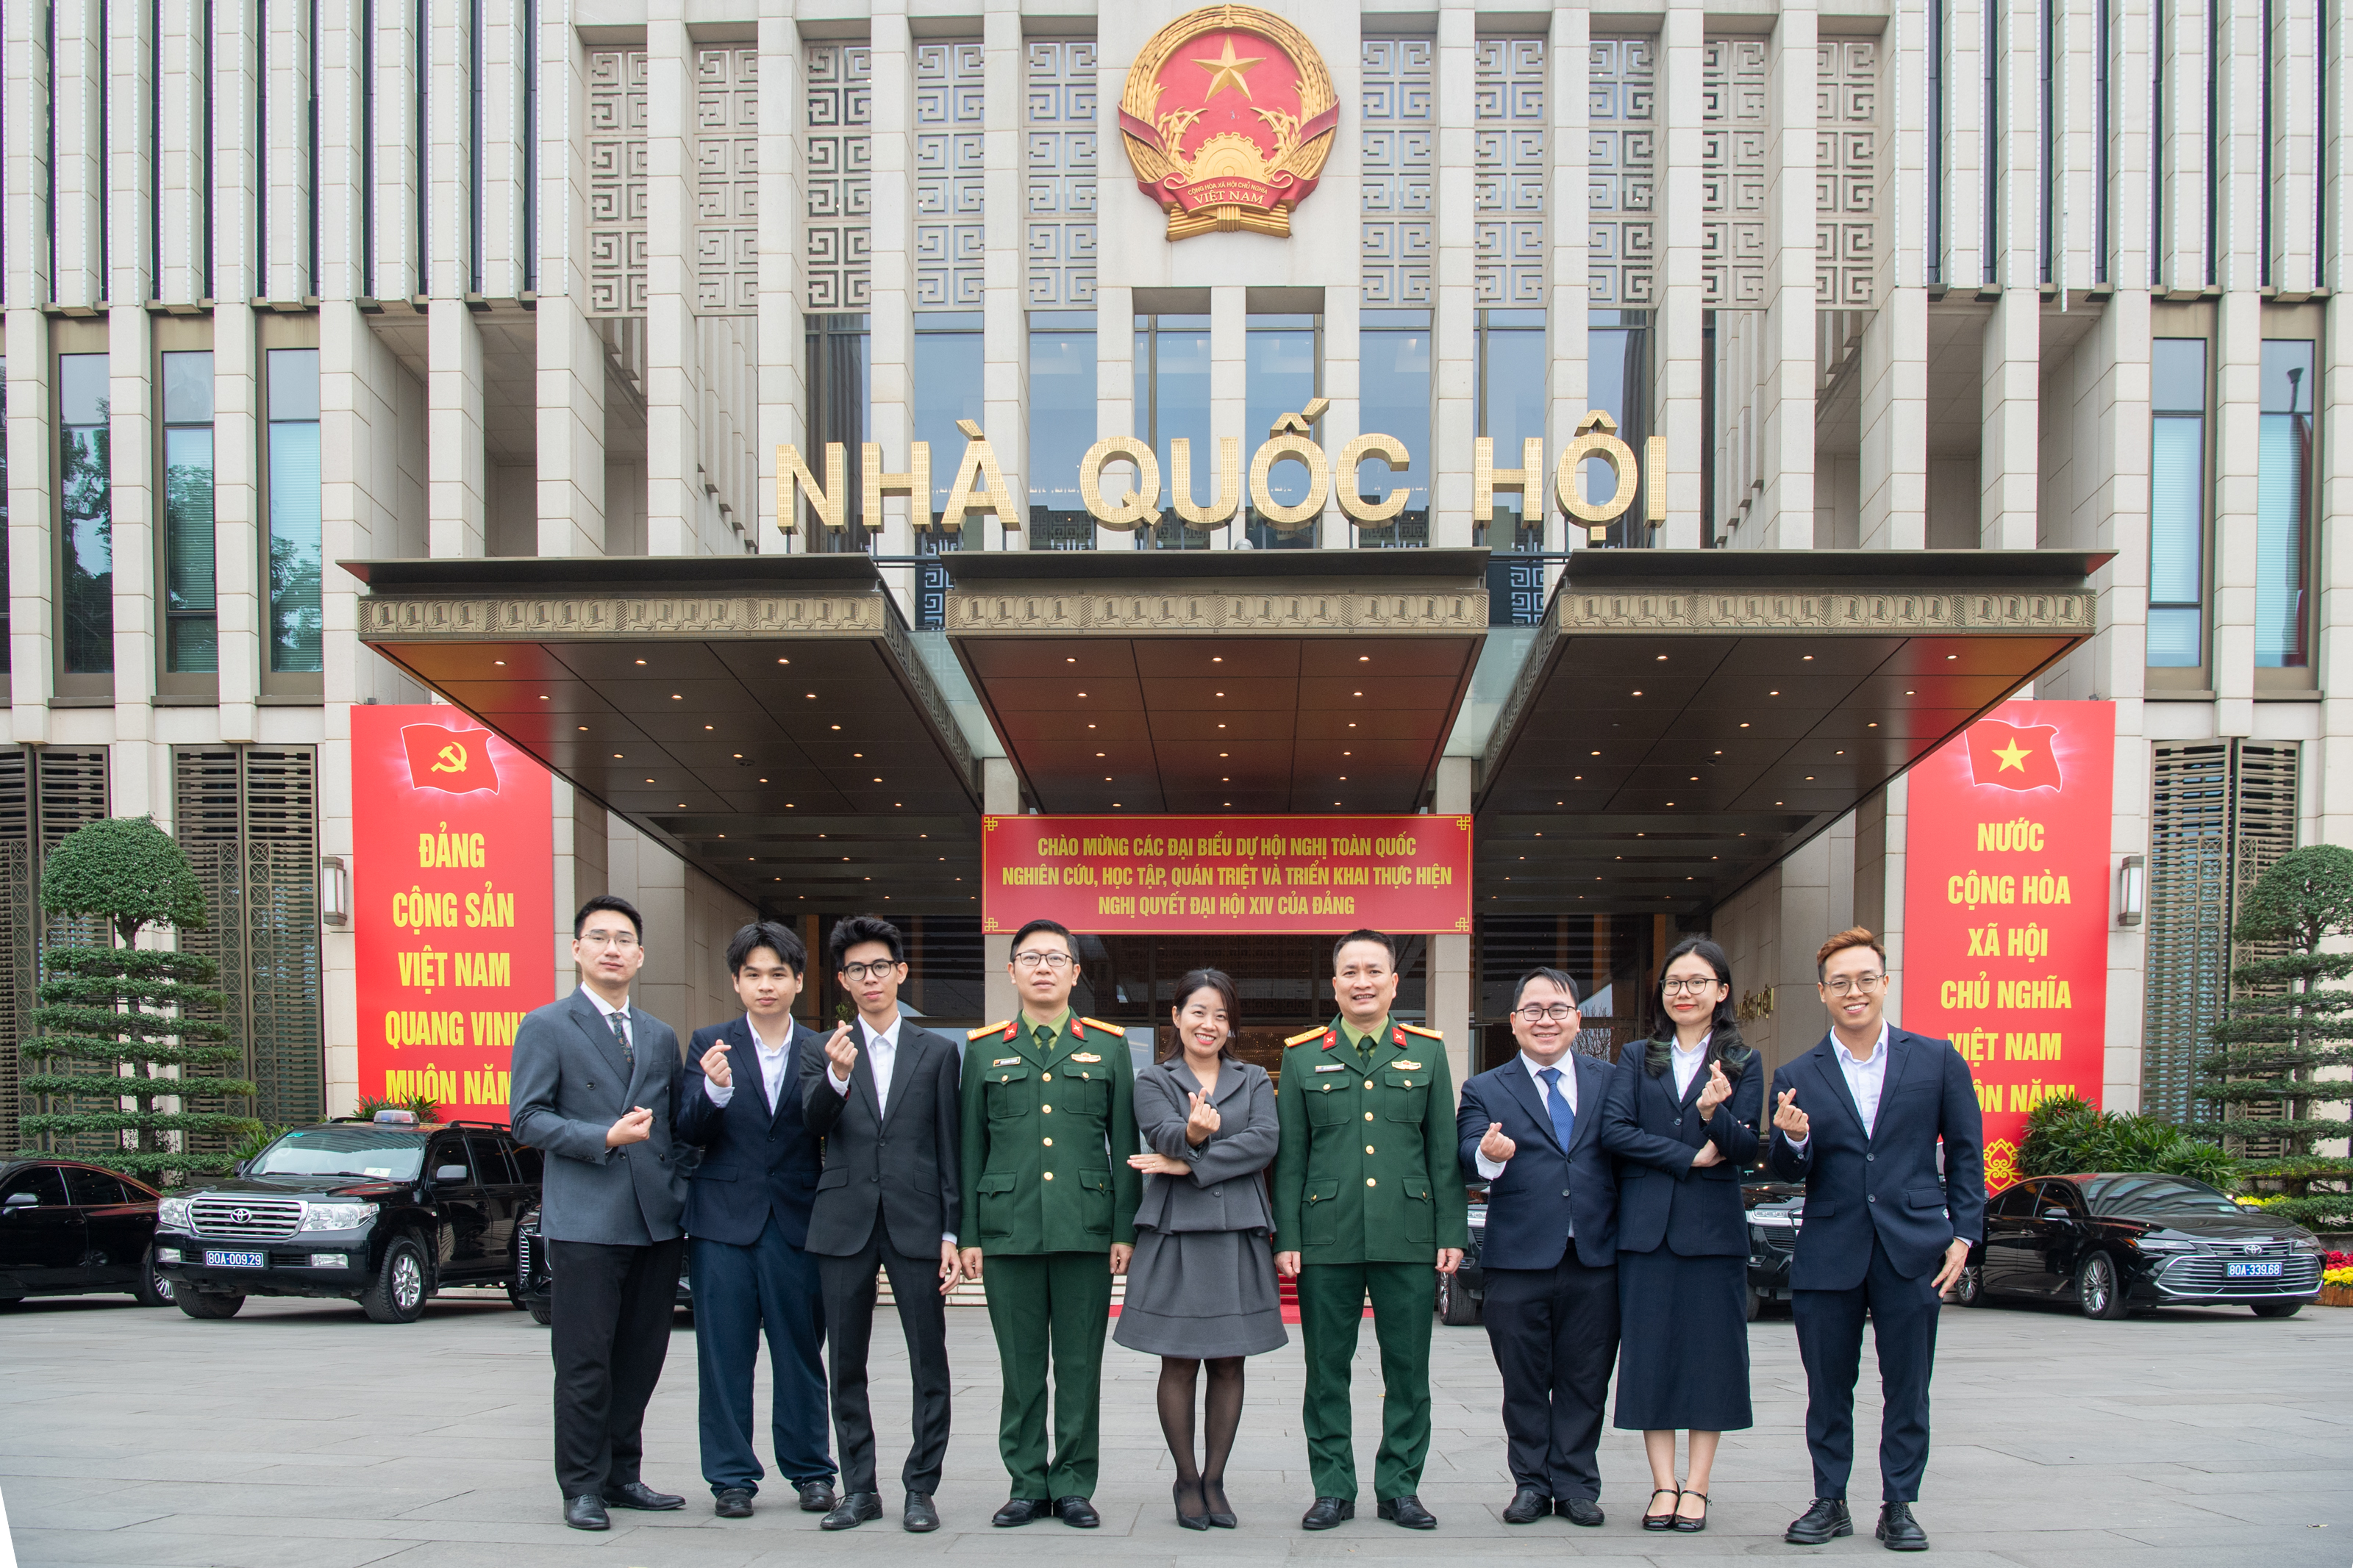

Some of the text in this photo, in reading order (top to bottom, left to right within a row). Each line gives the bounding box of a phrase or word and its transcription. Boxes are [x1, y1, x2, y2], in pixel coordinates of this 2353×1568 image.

[1188, 187, 1204, 196] CỘNG
[1204, 182, 1217, 190] HÒA
[1227, 181, 1237, 190] HỘI
[1238, 181, 1250, 190] CHỦ
[1251, 184, 1268, 195] NGHĨA
[1193, 190, 1264, 205] VIỆT NAM
[776, 398, 1666, 548] NHÀ QUỐC HỘI
[419, 821, 485, 868] ĐẢNG
[1038, 831, 1416, 859] CHÀO MỪNG CÁC ĐẠI BIỂU DỰ HỘI NGHỊ TOÀN QUỐC
[1977, 817, 2044, 852] NƯỚC
[1002, 859, 1452, 889] NGHIÊN CỨU, HỌC TẬP, QUÁN TRIỆT VÀ TRIỂN KHAI THỰC HIỆN
[1948, 869, 2071, 911] CỘNG HÒA
[393, 881, 515, 935] CỘNG SẢN
[1099, 890, 1354, 919] NGHỊ QUYẾT ĐẠI HỘI XIV CỦA ĐẢNG
[1967, 923, 2049, 963] XÃ HỘI
[398, 945, 510, 995] VIỆT NAM
[1735, 984, 1774, 1020] UỐC HỘI
[1941, 970, 2071, 1009] CHỦ NGHĨA
[385, 1010, 464, 1050] QUANG
[1948, 1027, 2062, 1067] VIỆT NAM
[385, 1063, 457, 1105] MUÔN
[1973, 1078, 2003, 1112] ÔN
[208, 1253, 262, 1266] 80A-009.29
[2229, 1264, 2280, 1276] 80A-339.68
